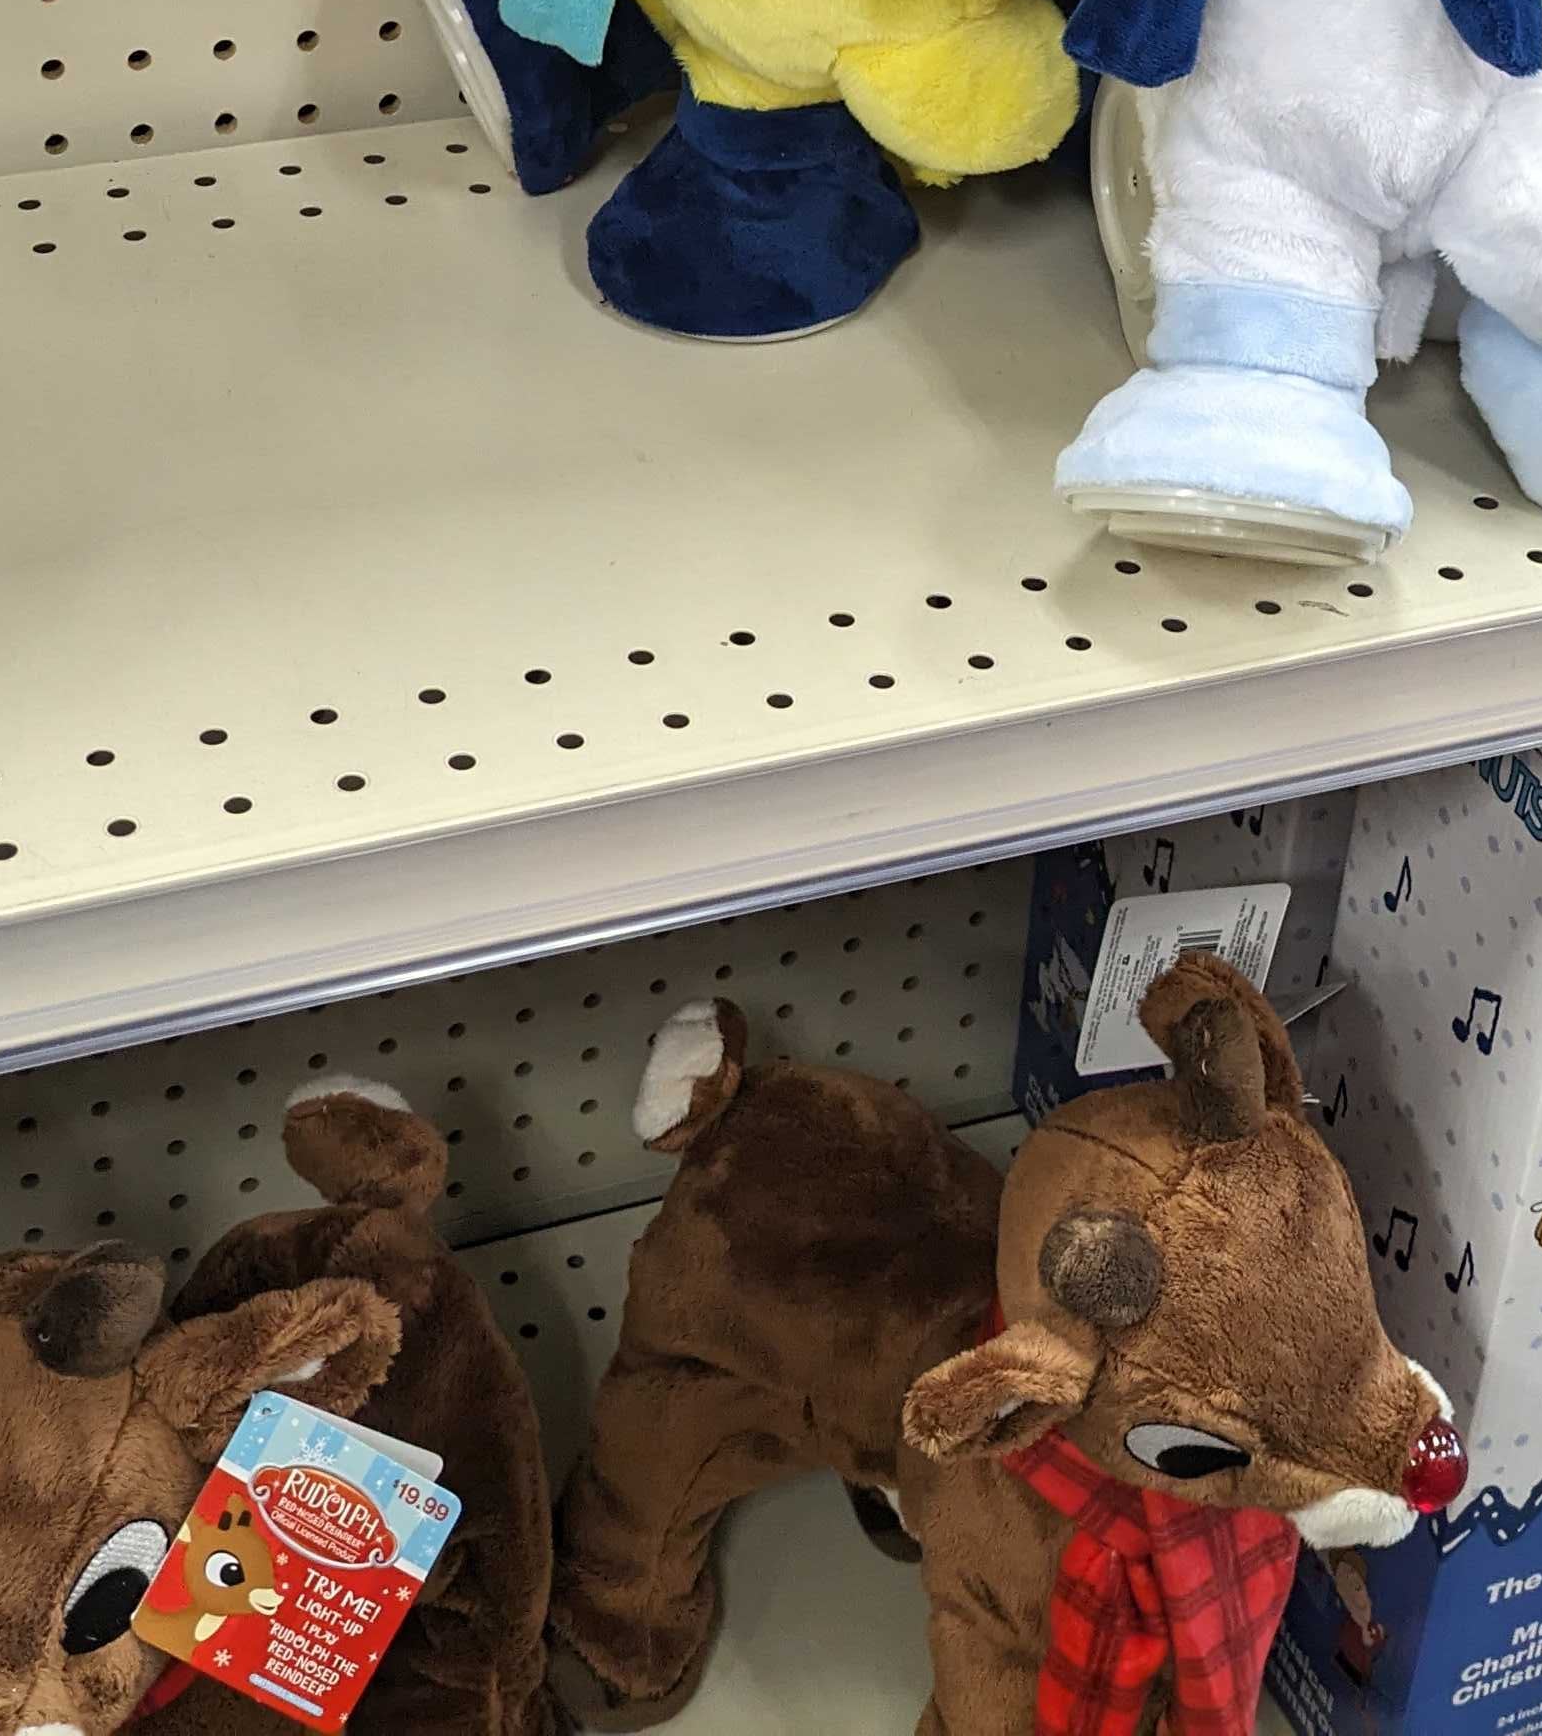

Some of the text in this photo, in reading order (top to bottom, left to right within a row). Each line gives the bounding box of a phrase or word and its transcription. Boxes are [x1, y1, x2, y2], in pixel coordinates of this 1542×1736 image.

[280, 1468, 380, 1541] RUDOLPH
[392, 1478, 451, 1523] $19.99
[270, 1510, 358, 1565] Official Licensed Product
[304, 1567, 382, 1624] TRY ME!
[1486, 1572, 1542, 1604] The
[295, 1594, 364, 1637] LIGHT-UP
[302, 1620, 340, 1646] I PLAY
[267, 1639, 341, 1686] RED-NOSED
[269, 1618, 360, 1678] "RUDOLPH THE
[265, 1657, 332, 1698] REINDEER"
